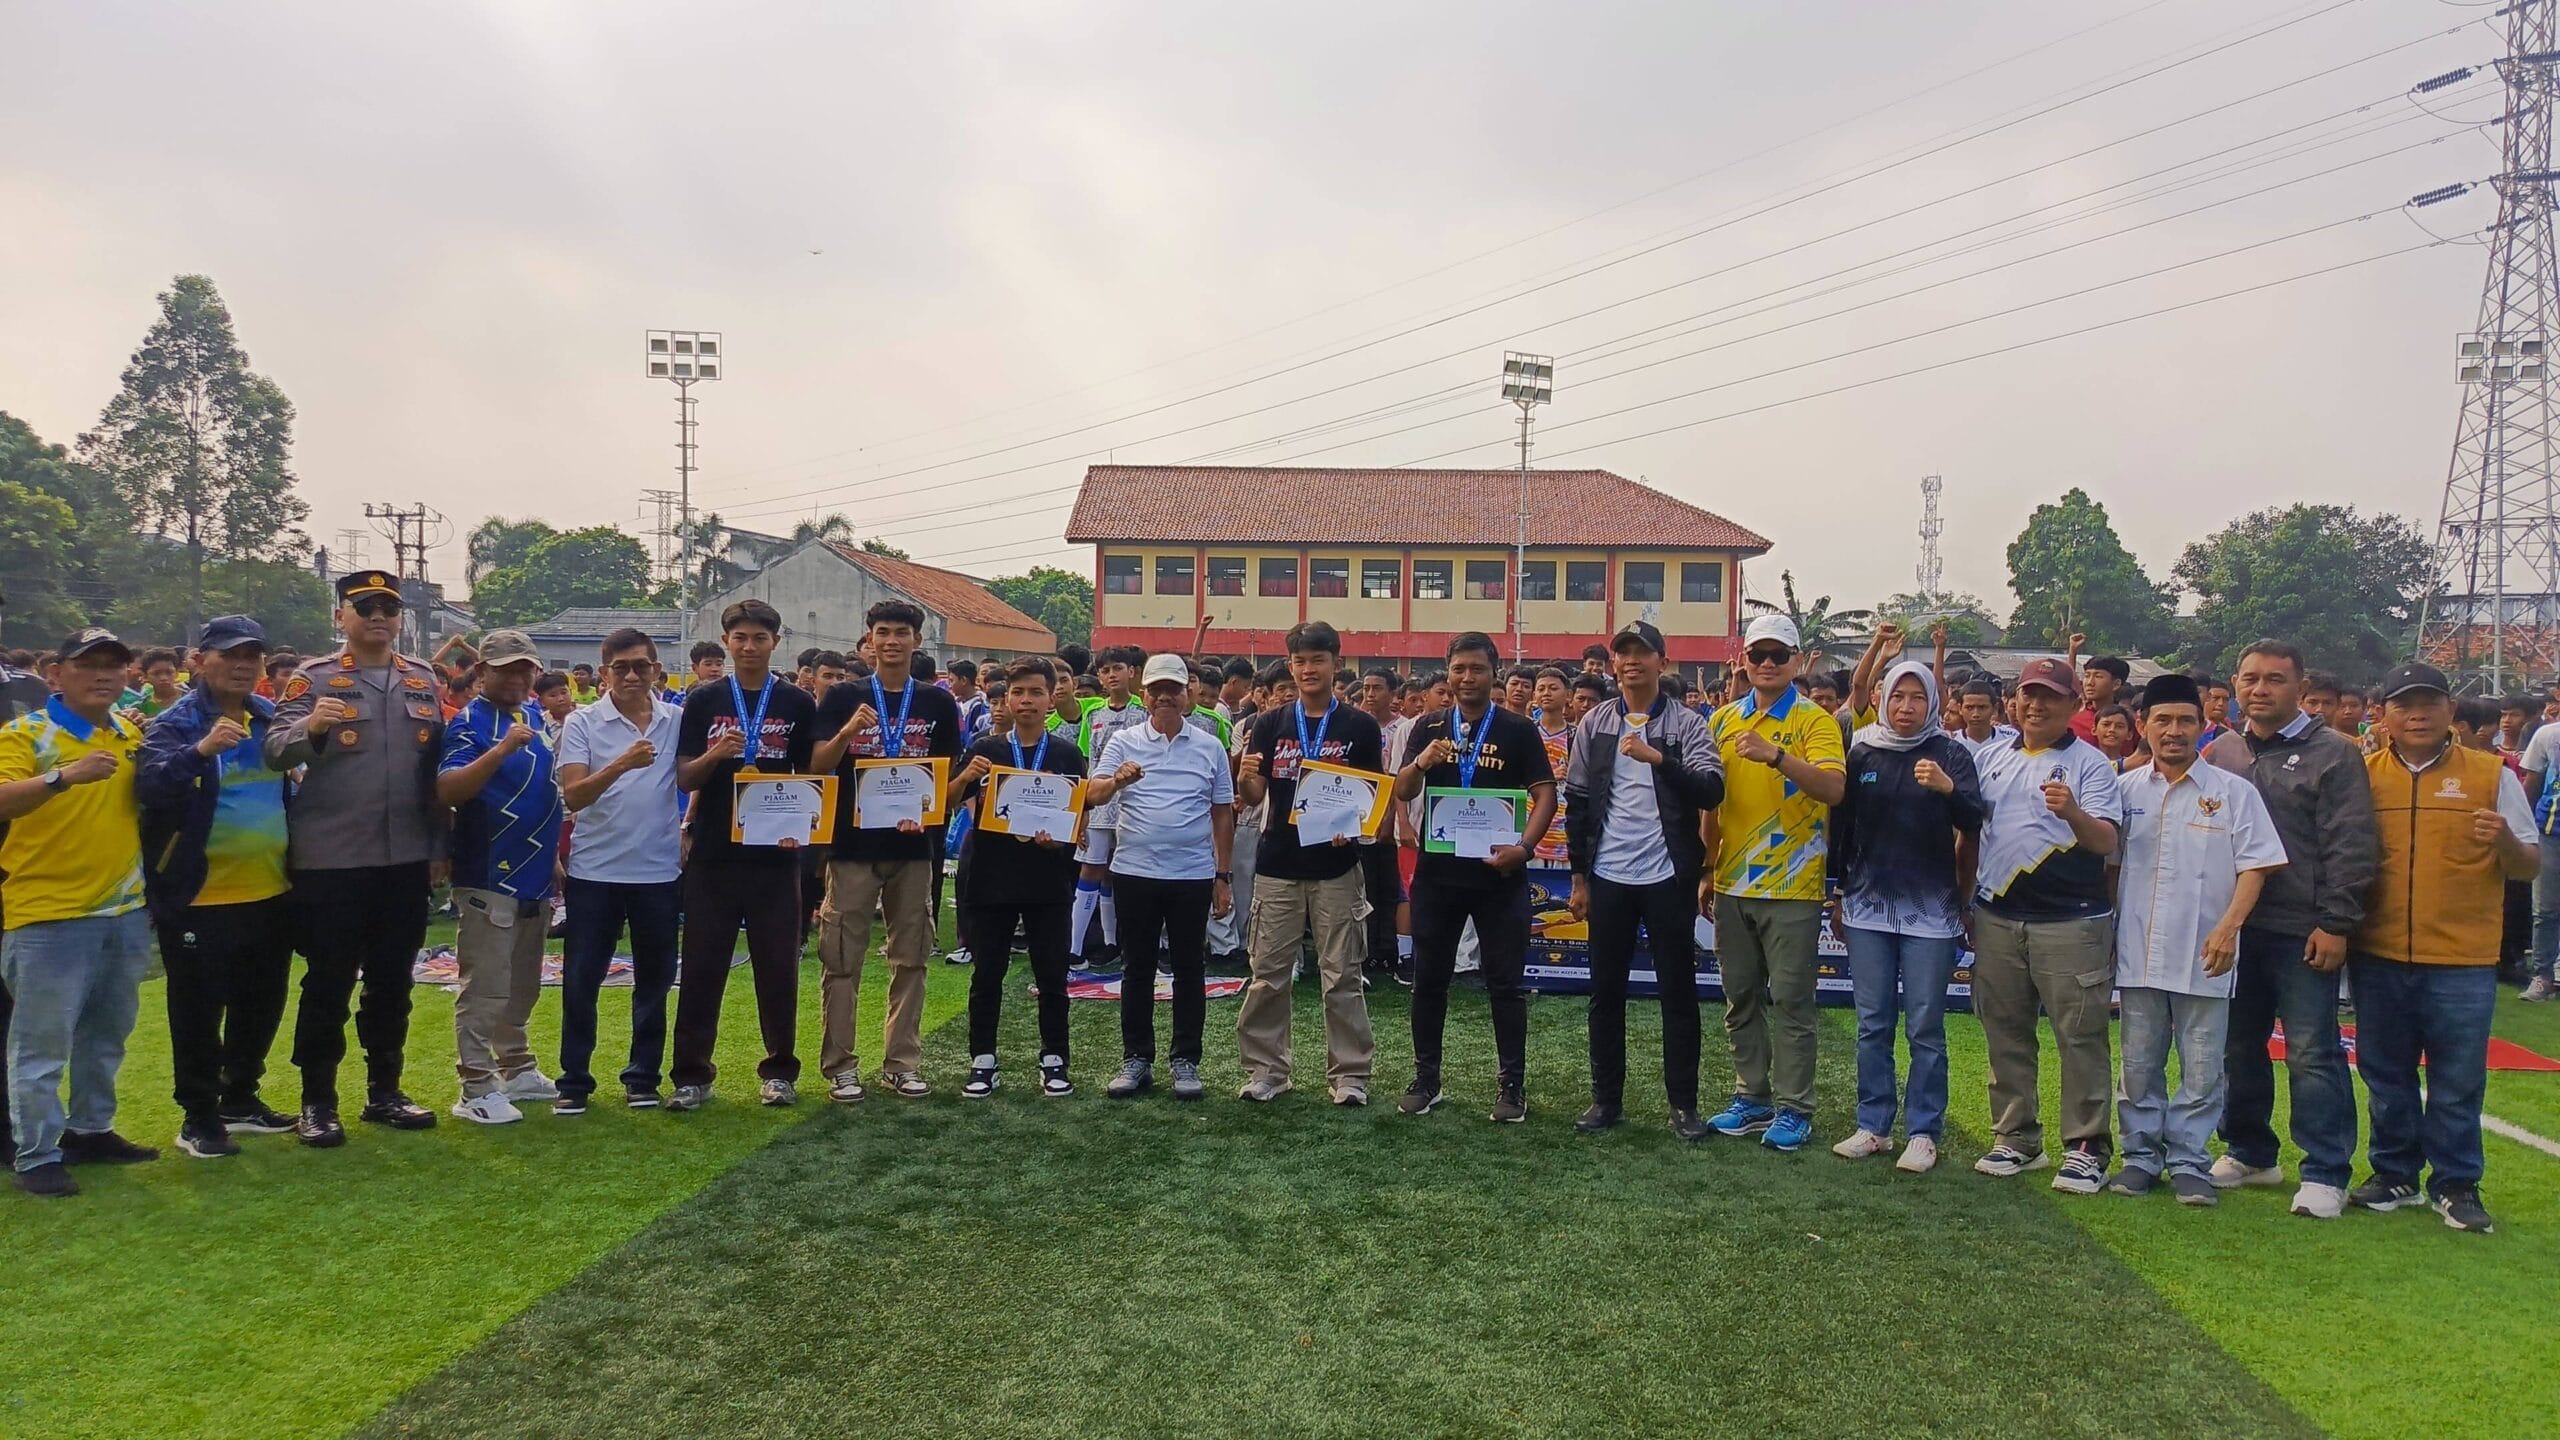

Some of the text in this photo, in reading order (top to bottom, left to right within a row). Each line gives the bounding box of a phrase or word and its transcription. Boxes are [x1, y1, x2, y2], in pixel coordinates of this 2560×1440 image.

[1468, 742, 1498, 755] SEP
[1446, 752, 1505, 771] ETNITY
[880, 778, 911, 786] PIAGAM
[1322, 785, 1352, 796] PIAGAM
